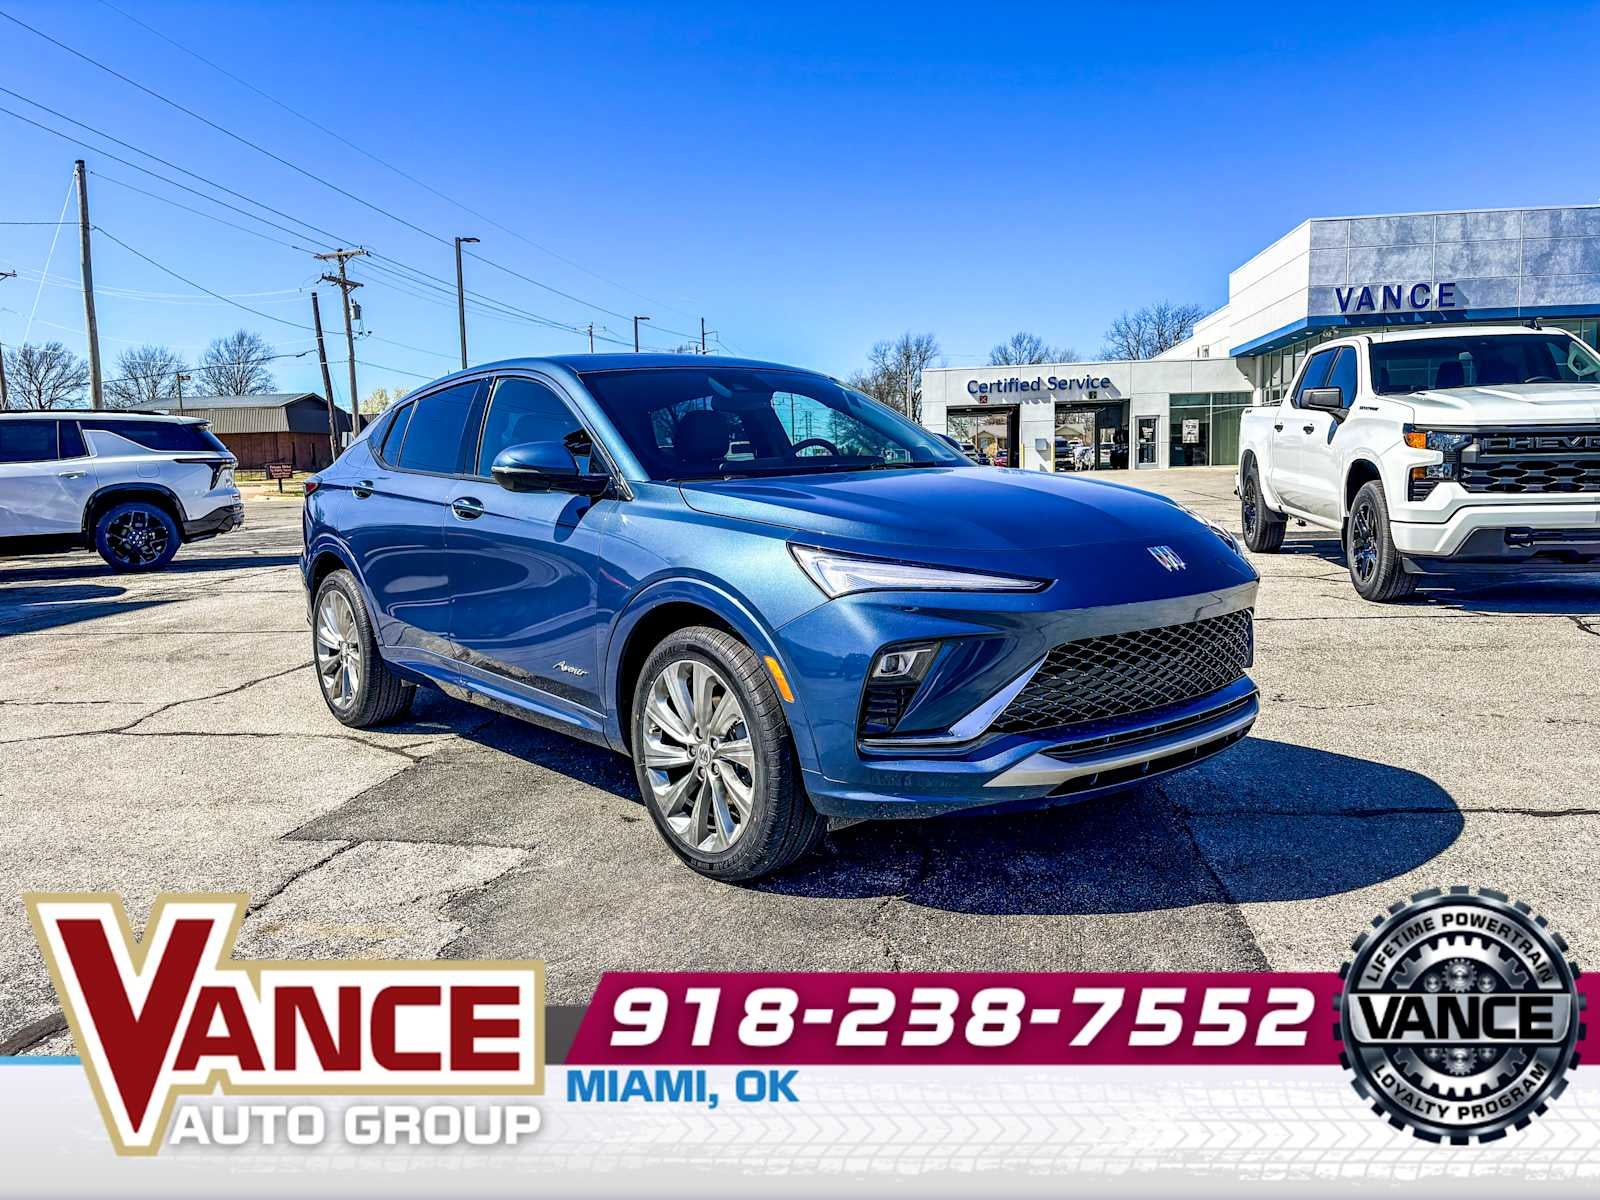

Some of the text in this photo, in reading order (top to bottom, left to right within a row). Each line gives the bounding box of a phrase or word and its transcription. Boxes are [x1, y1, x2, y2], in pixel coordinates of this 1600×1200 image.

[1335, 282, 1456, 313] VANCE
[967, 374, 1111, 394] Certified Service
